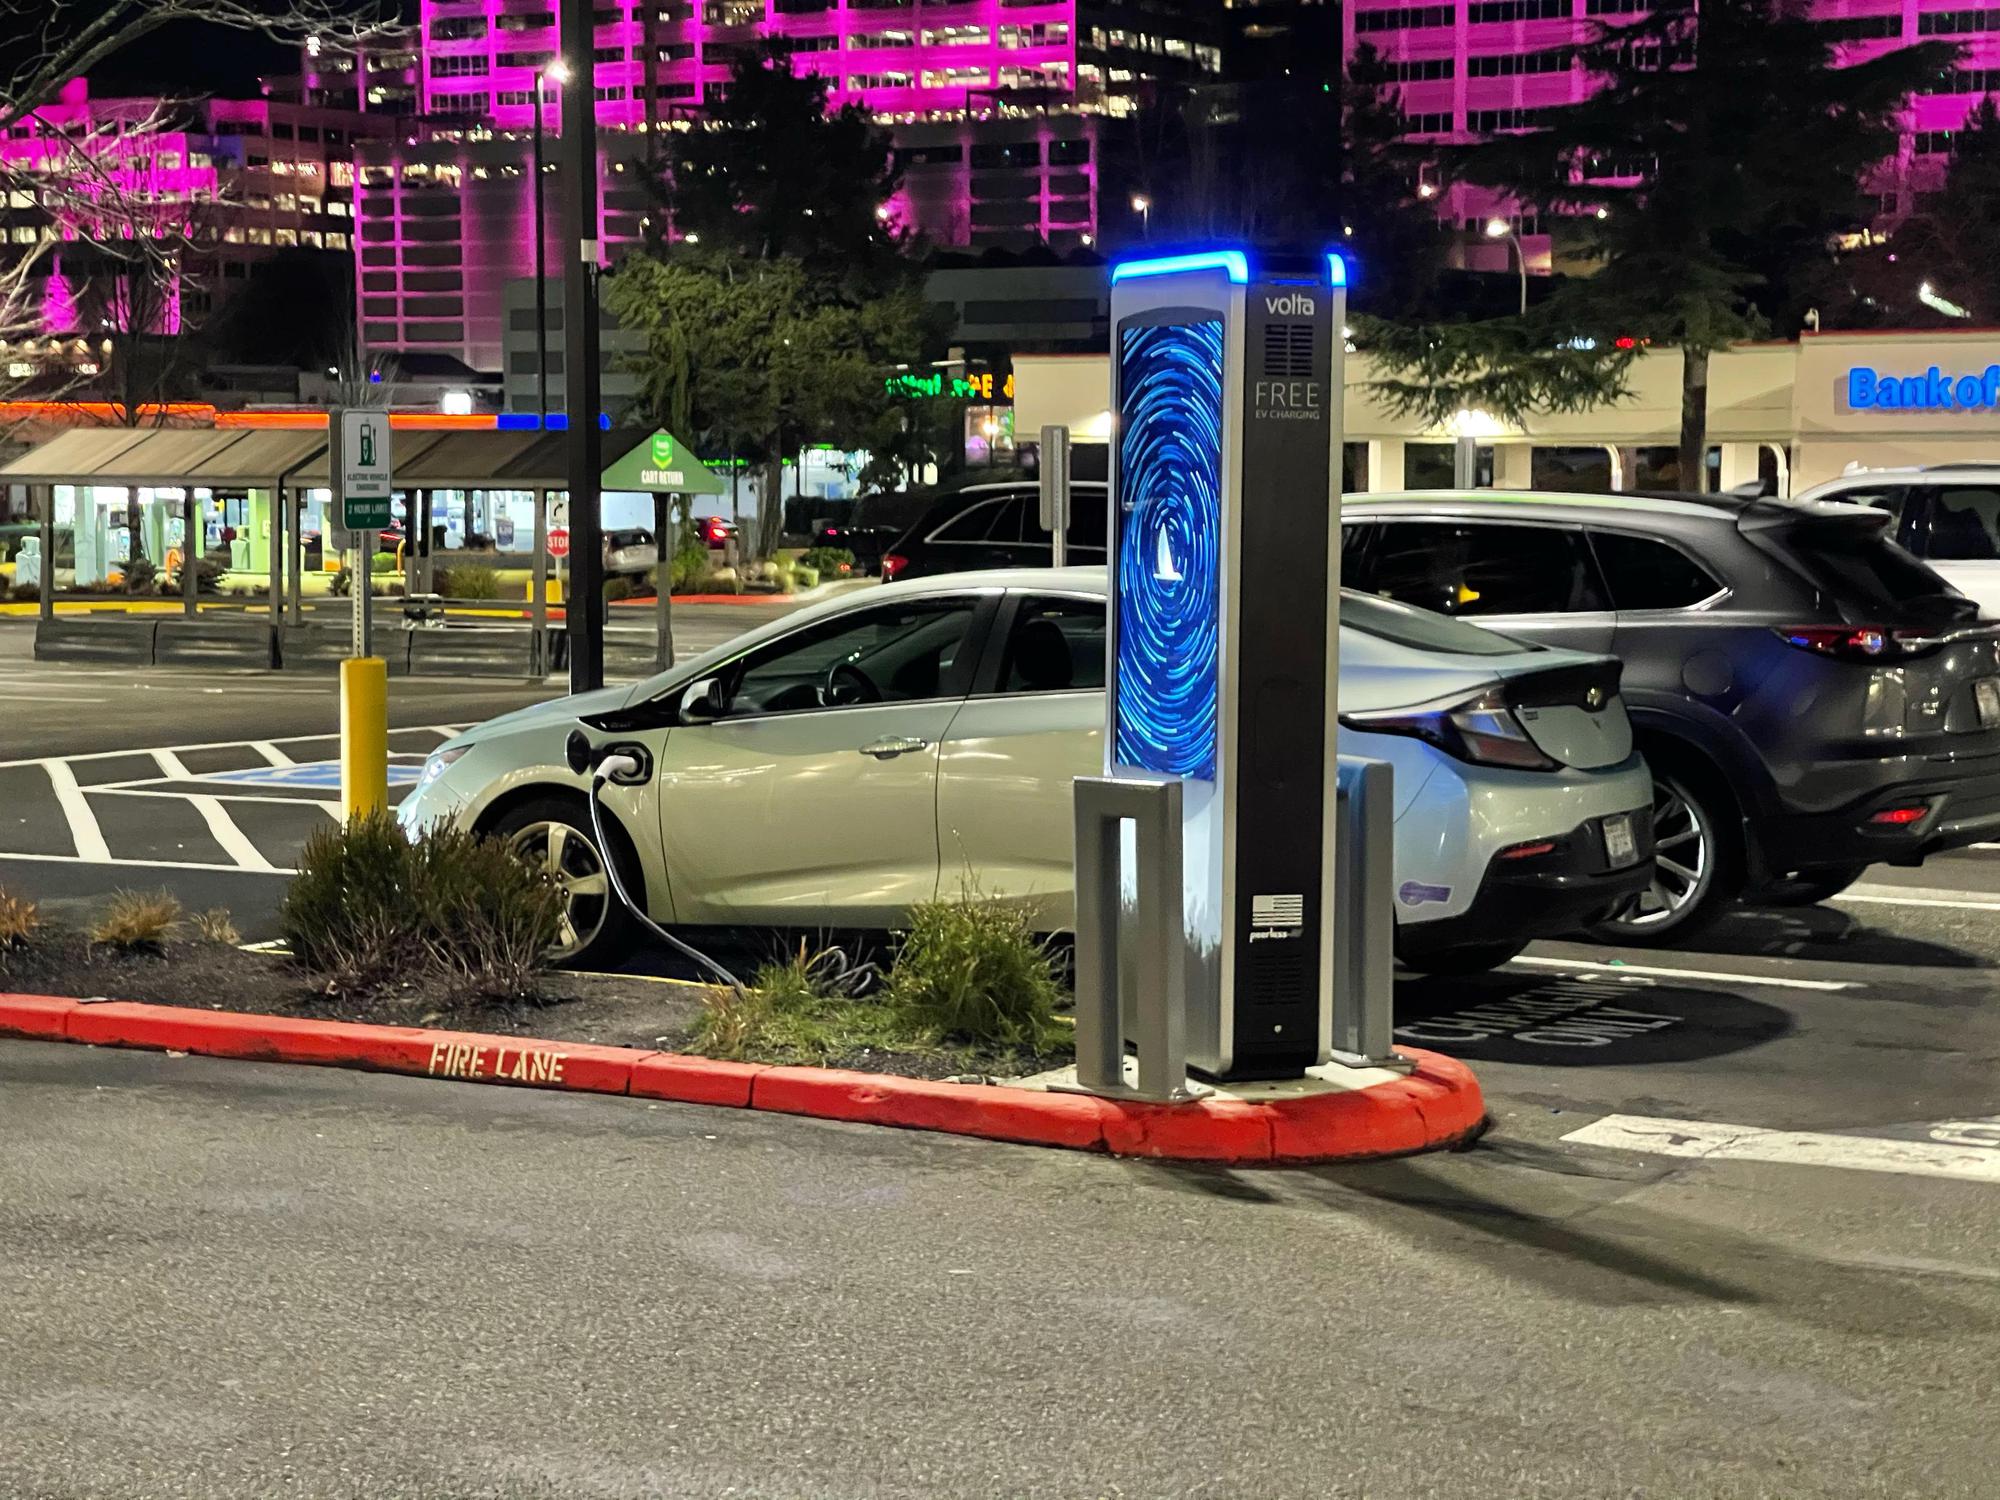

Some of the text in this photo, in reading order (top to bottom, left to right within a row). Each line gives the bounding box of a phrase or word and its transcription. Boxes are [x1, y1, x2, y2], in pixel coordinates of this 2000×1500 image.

[1266, 294, 1315, 315] volta
[1255, 382, 1320, 408] FREE
[1849, 364, 2000, 408] Bank of
[1255, 410, 1320, 420] EV CHARGING
[641, 470, 684, 486] CART RETURN
[354, 503, 371, 515] HOUR
[371, 503, 388, 515] LIMIT
[1249, 926, 1288, 943] peerless
[1513, 1007, 1685, 1046] ONLY
[428, 1043, 569, 1082] FIRE LANE
